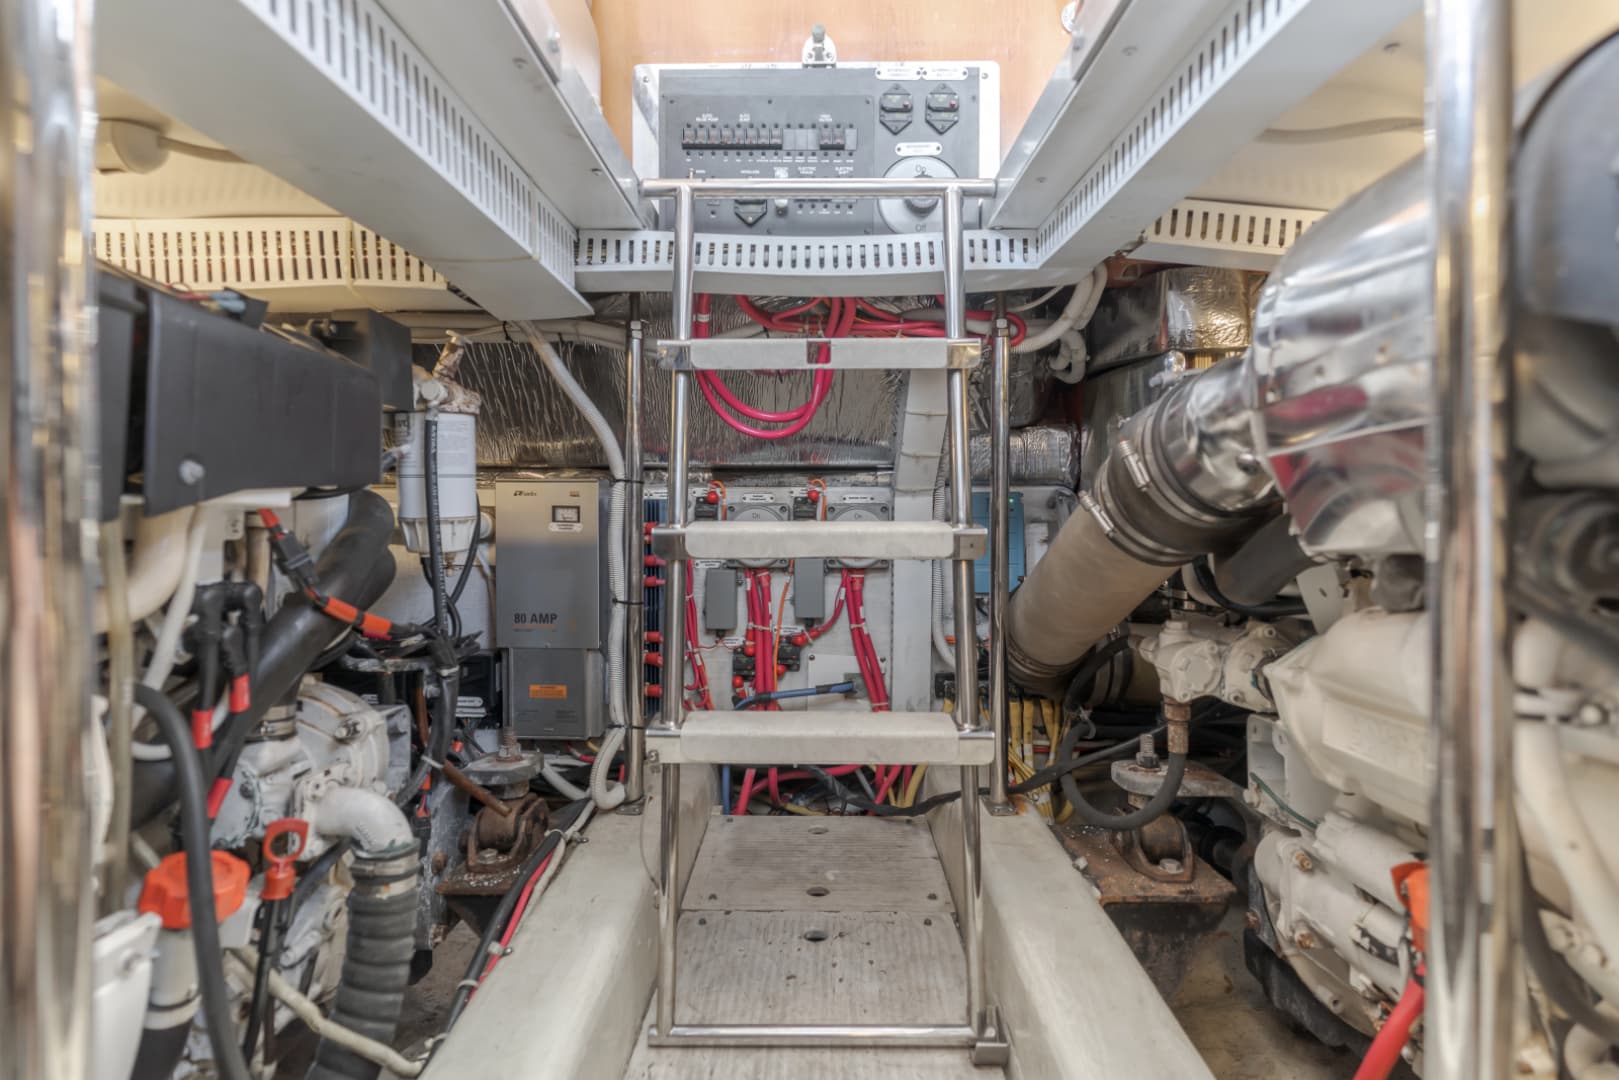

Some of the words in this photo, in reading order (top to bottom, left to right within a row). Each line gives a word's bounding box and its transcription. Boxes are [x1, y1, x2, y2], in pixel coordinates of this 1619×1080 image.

[915, 164, 927, 173] On
[915, 223, 927, 233] Off
[514, 612, 527, 624] 80
[530, 612, 558, 624] AMP
